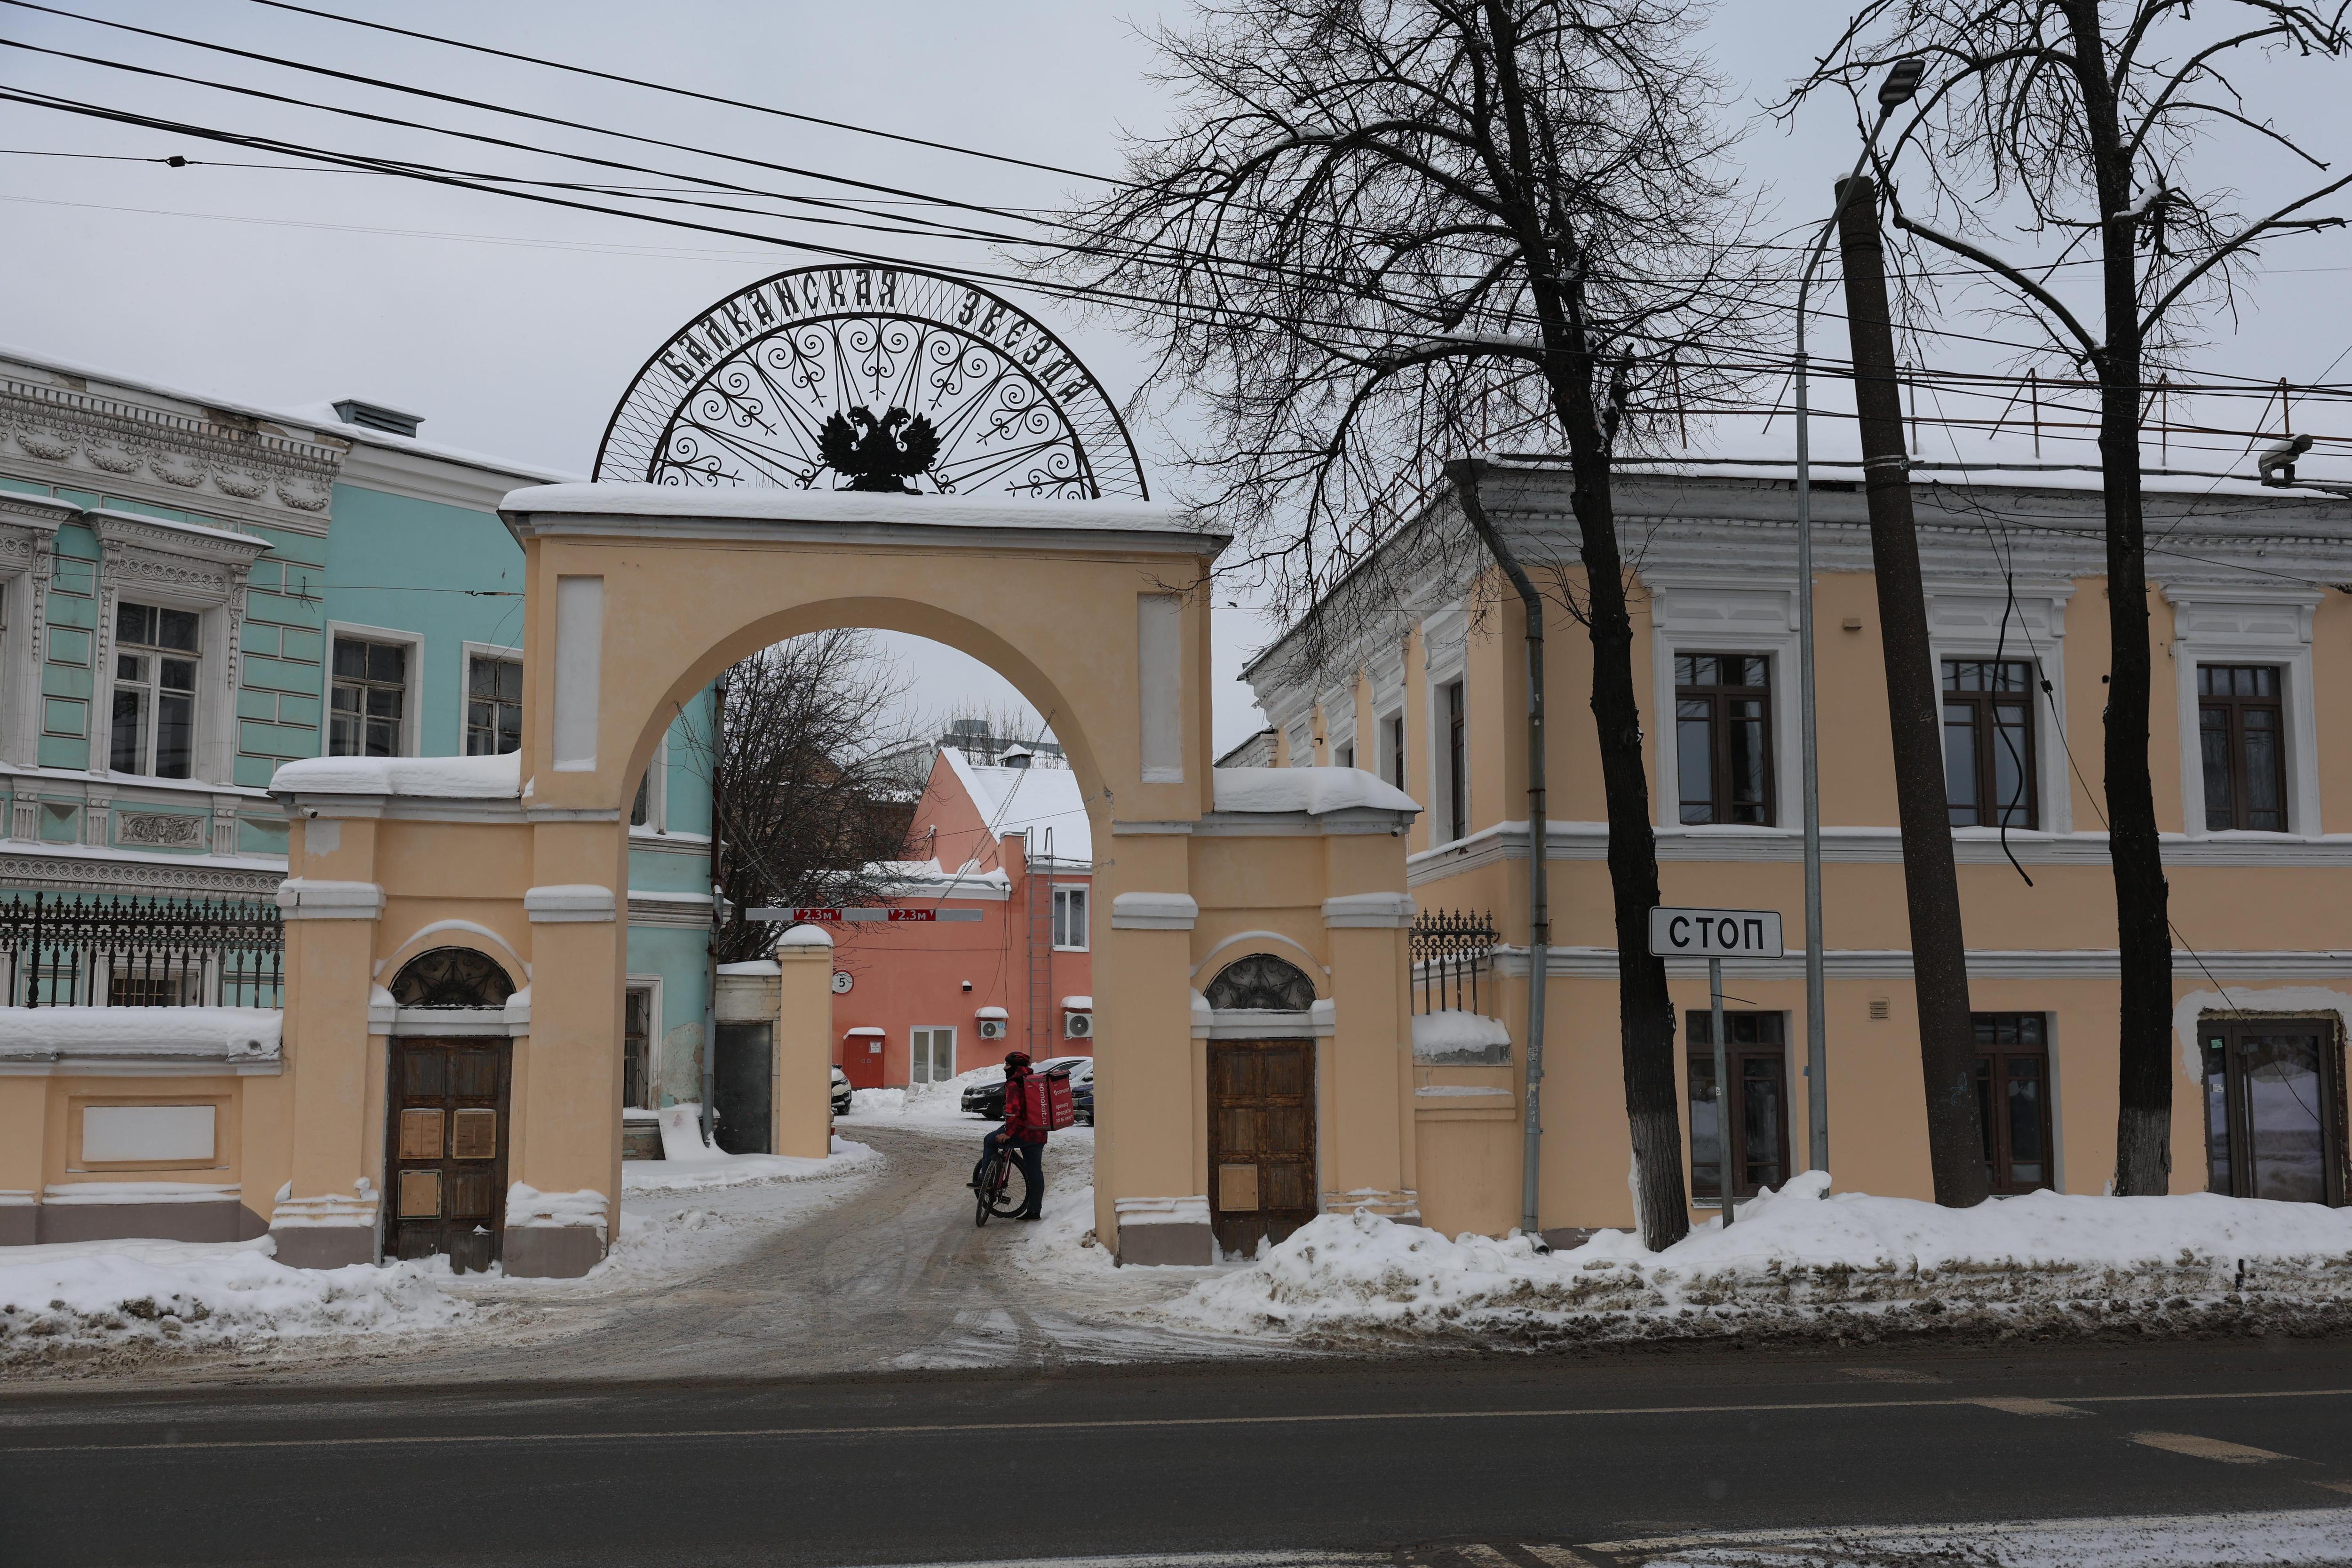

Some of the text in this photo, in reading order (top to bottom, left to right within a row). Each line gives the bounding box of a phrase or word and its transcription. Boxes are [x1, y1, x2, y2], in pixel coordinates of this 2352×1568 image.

[659, 270, 1092, 404] БАЛКАНСКАЯ ЗВЕЗДА
[1669, 915, 1764, 949] СТОП
[839, 978, 845, 987] 5
